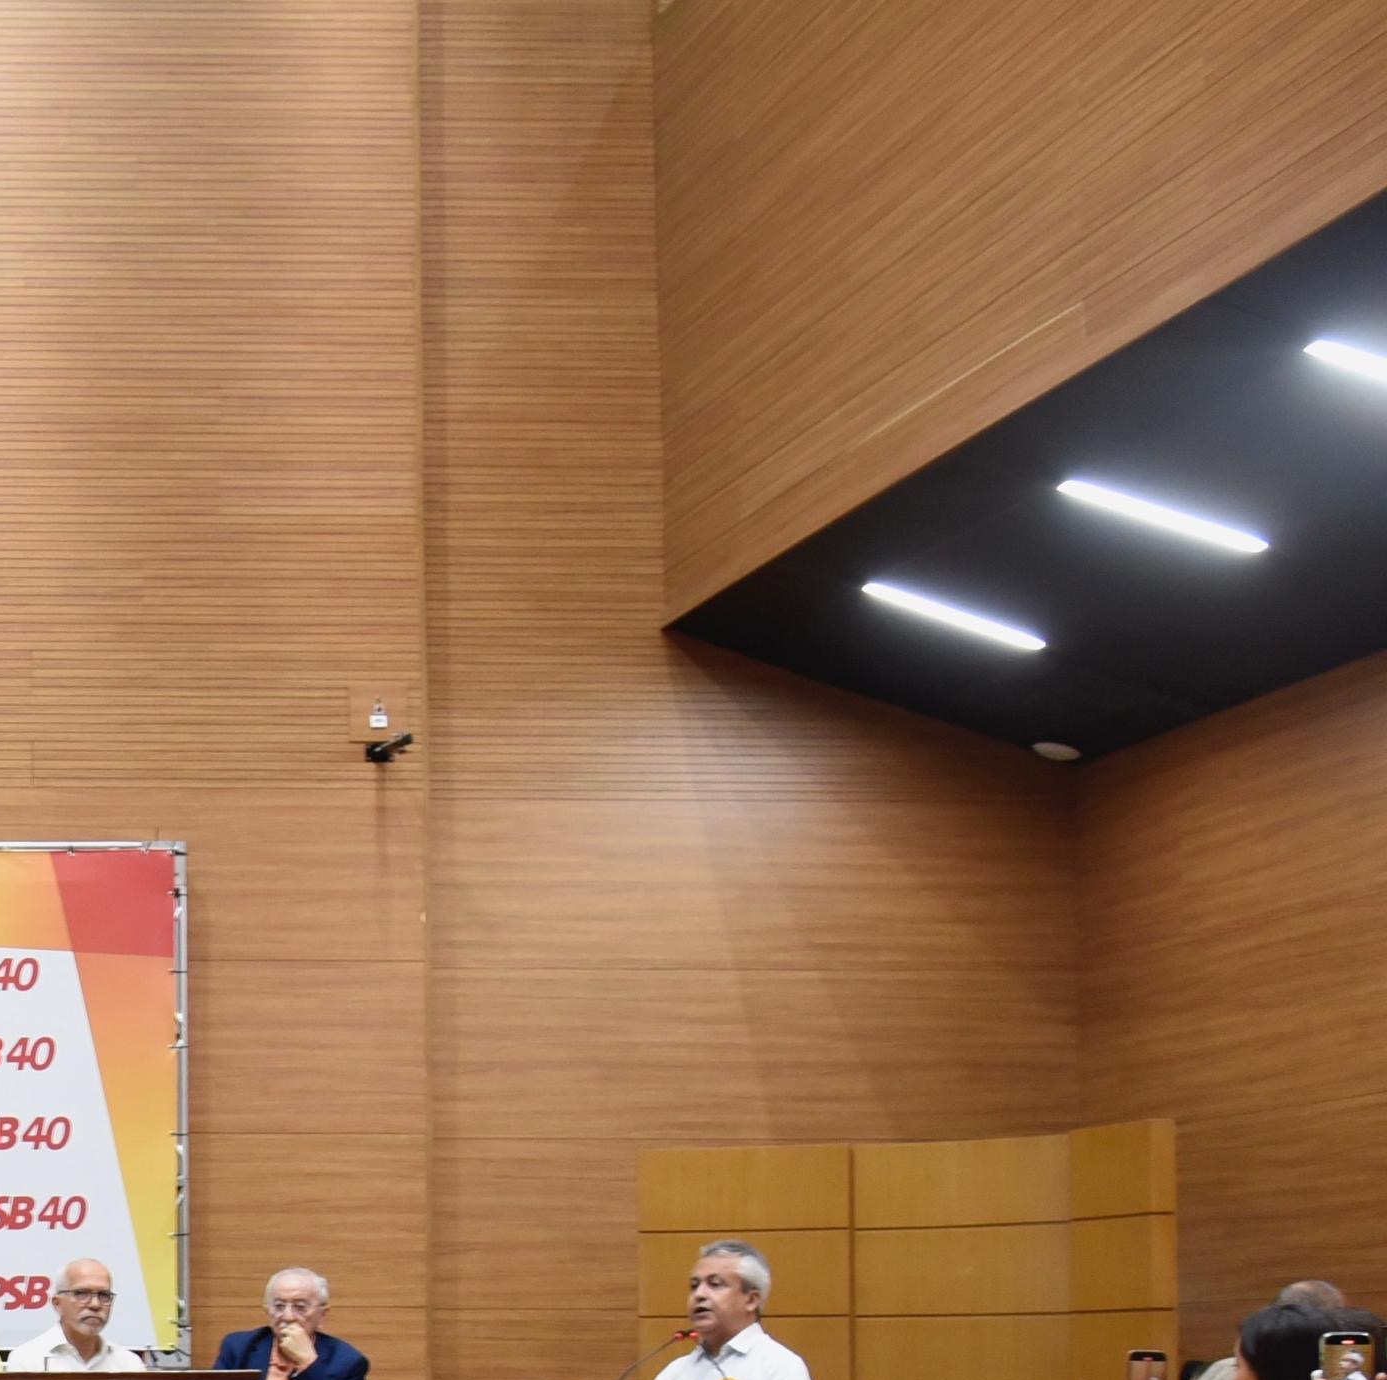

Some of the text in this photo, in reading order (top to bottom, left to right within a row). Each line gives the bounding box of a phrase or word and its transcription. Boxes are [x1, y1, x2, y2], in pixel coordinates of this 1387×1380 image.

[7, 1037, 56, 1071] 40
[22, 1116, 72, 1150] 40
[38, 1195, 88, 1230] 40
